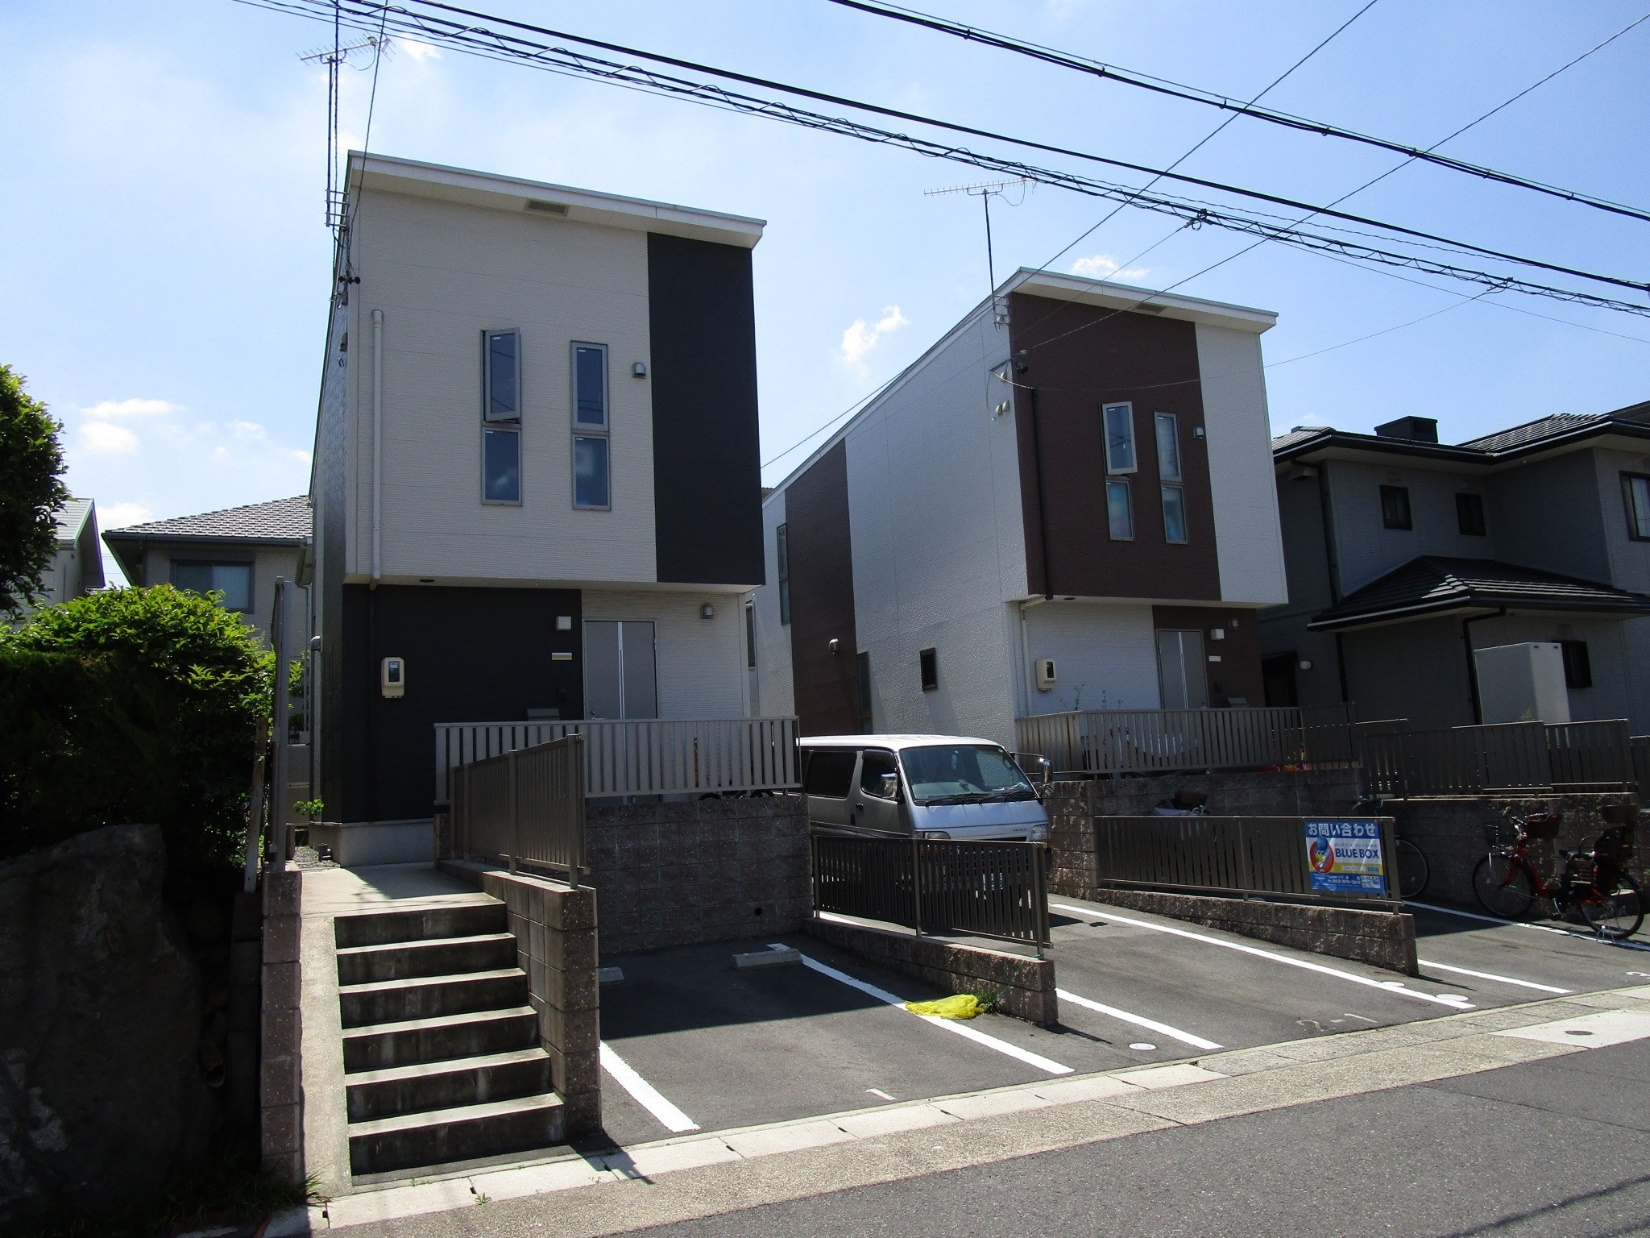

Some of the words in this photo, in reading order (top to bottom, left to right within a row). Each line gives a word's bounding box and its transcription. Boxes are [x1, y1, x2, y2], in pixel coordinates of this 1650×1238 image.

[1308, 823, 1376, 837] お問い合わせ
[1335, 848, 1358, 858] BLUE
[1360, 849, 1379, 859] BOX
